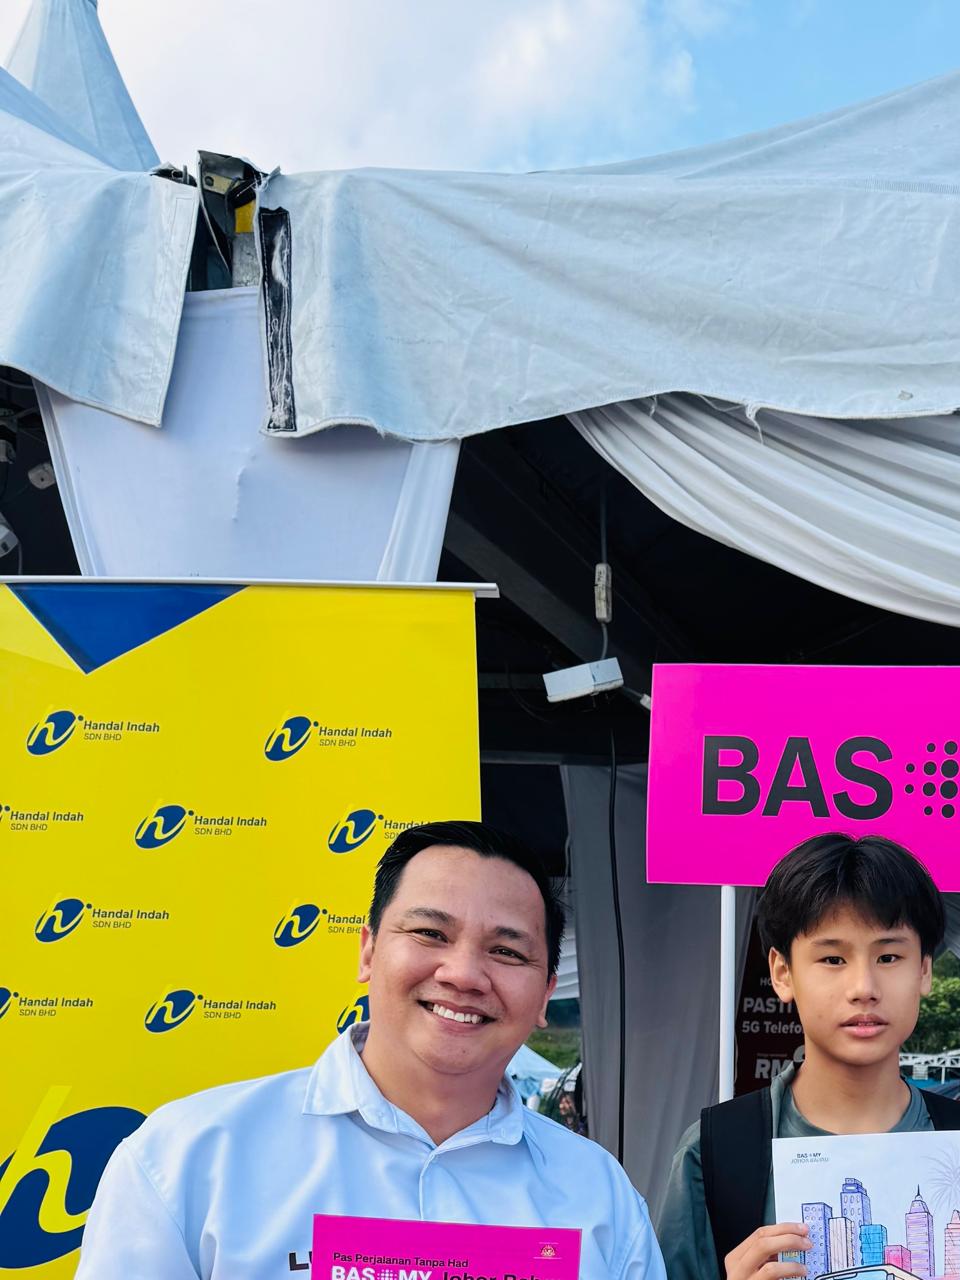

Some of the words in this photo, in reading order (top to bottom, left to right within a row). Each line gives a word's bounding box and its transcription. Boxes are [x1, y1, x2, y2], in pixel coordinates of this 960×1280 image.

[83, 719, 124, 732] Handal
[126, 721, 160, 733] Indah
[84, 732, 100, 741] SDN
[103, 733, 122, 742] BHD
[318, 726, 358, 738] Handal
[361, 727, 392, 739] Indah
[319, 738, 336, 746] SDN
[338, 739, 356, 747] BHD
[701, 735, 894, 821] BAS
[10, 810, 49, 822] Handal
[52, 812, 84, 823] Indah
[194, 815, 234, 827] Handal
[236, 816, 267, 828] Indah
[10, 822, 26, 831] SDN
[28, 823, 48, 832] BHD
[384, 819, 424, 830] Hand
[194, 827, 211, 836] SDN
[214, 828, 232, 836] BHD
[92, 908, 132, 920] Handal
[136, 909, 170, 921] Indah
[328, 914, 366, 924] Handal
[92, 920, 110, 928] SDN
[112, 920, 132, 929] BHD
[328, 926, 344, 934] SDN
[18, 996, 58, 1008] Handal
[61, 997, 94, 1009] Indah
[203, 999, 243, 1011] Handal
[246, 1000, 277, 1012] Indah
[19, 1008, 36, 1016] SDN
[38, 1008, 56, 1017] BHD
[204, 1010, 220, 1019] SDN
[223, 1012, 242, 1020] BHD
[742, 1021, 760, 1033] 5G
[764, 1021, 804, 1034] Telefo
[333, 1252, 352, 1262] Pas
[355, 1254, 412, 1266] Perjalanan
[414, 1256, 445, 1269] Tanpa
[448, 1258, 469, 1269] Had
